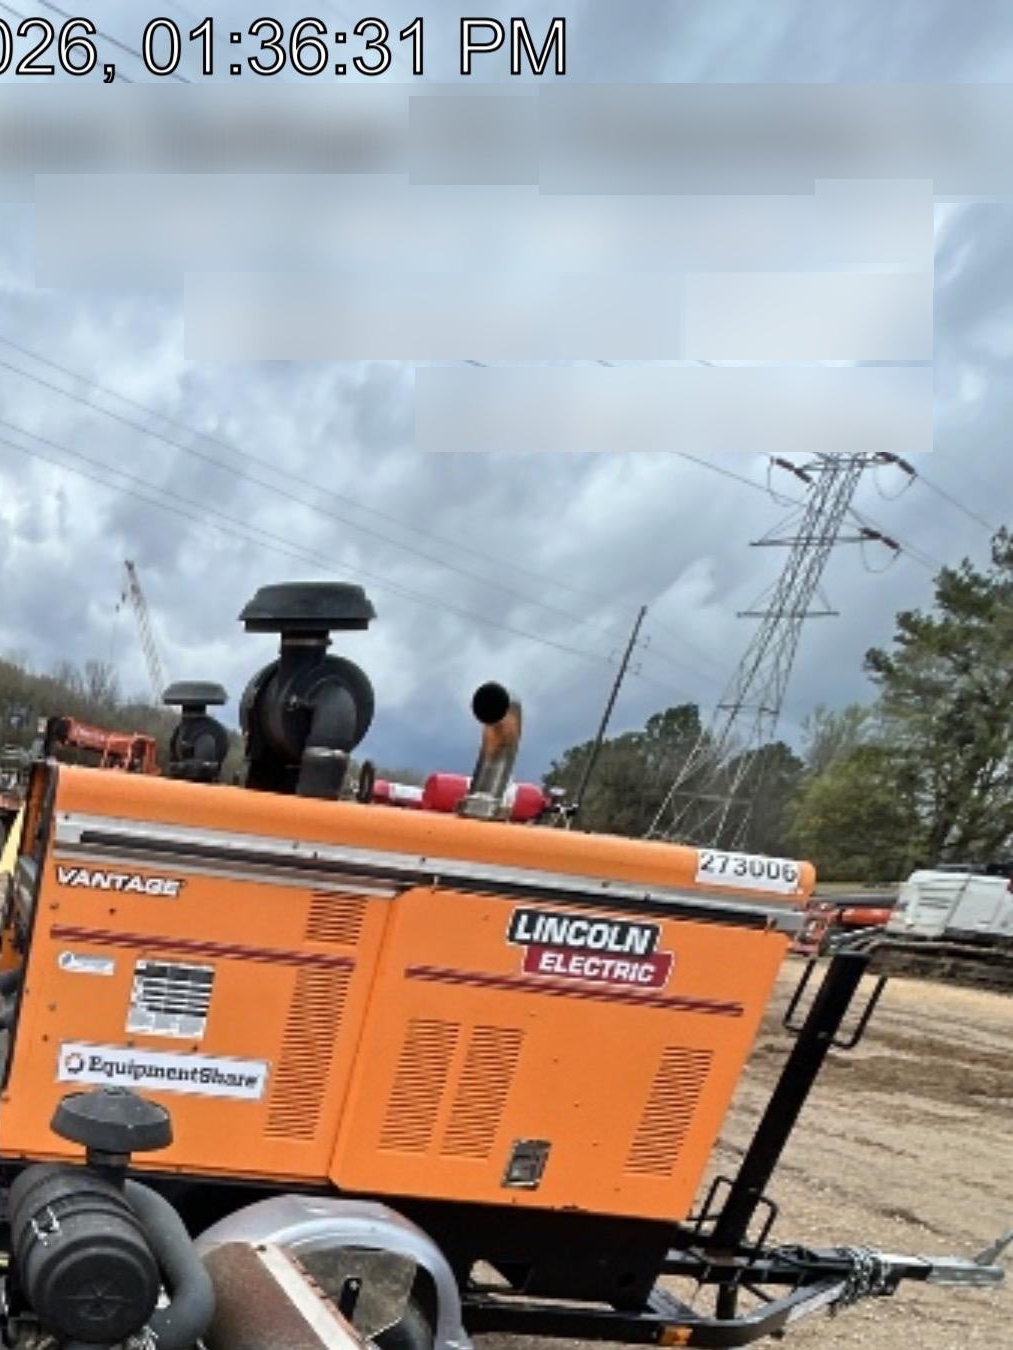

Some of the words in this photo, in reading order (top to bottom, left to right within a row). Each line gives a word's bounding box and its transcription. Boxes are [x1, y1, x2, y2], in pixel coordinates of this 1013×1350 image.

[55, 865, 184, 898] VANTAGE
[699, 851, 798, 884] 273006
[514, 913, 652, 954] LINCOLN
[538, 952, 656, 983] ELECTRIC
[88, 1055, 259, 1090] EquipmentShare
